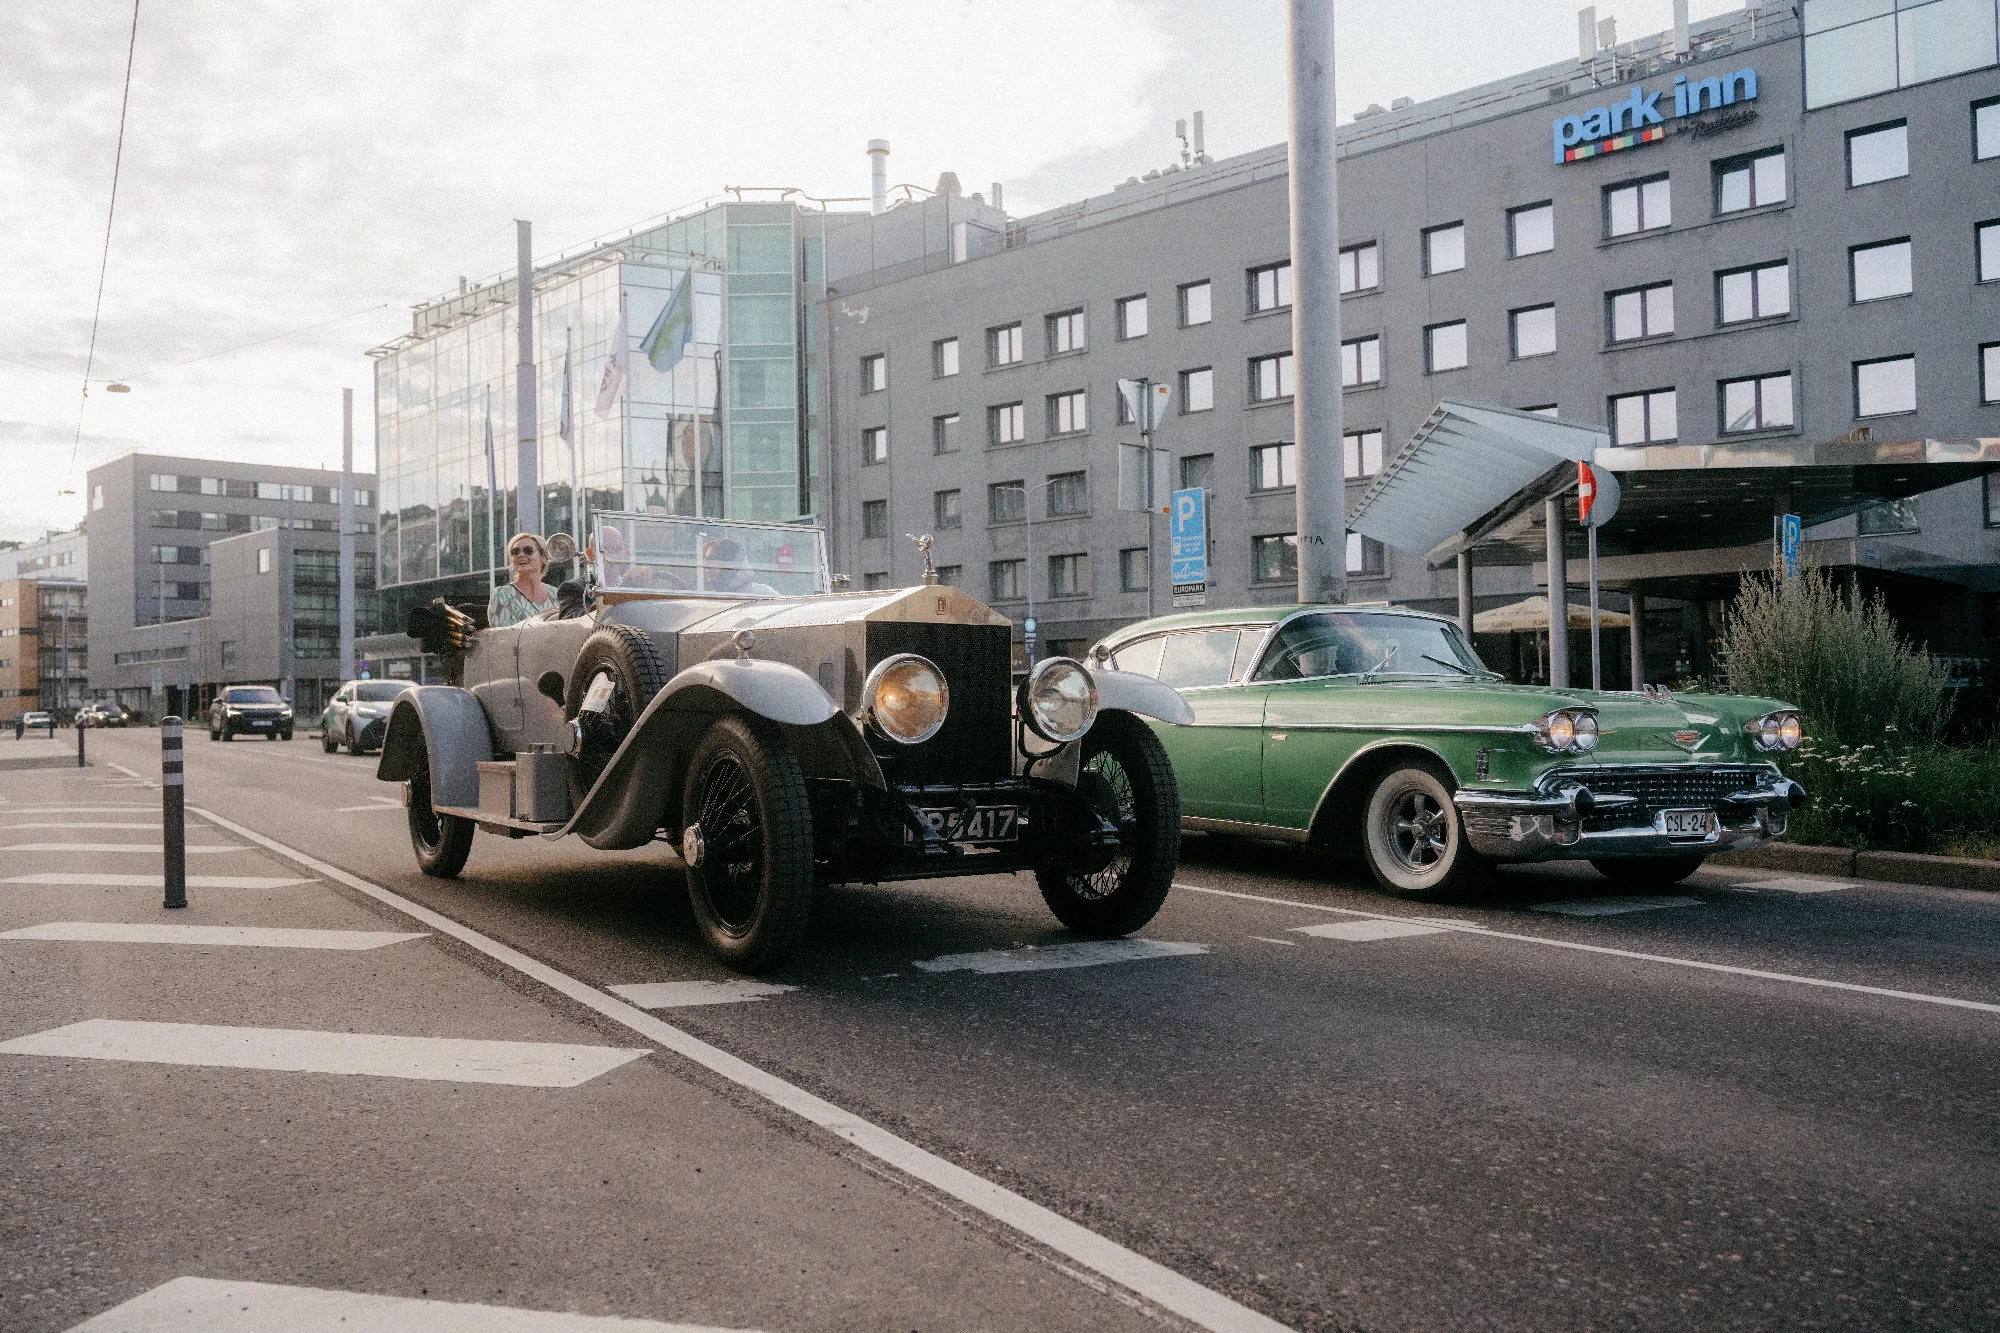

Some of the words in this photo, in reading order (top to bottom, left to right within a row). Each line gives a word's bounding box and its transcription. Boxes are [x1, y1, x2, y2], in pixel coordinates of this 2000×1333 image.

[1554, 86, 1663, 164] park
[1674, 68, 1757, 117] inn
[1178, 496, 1195, 532] P
[1789, 521, 1797, 553] P
[1174, 584, 1204, 594] EUROPARK
